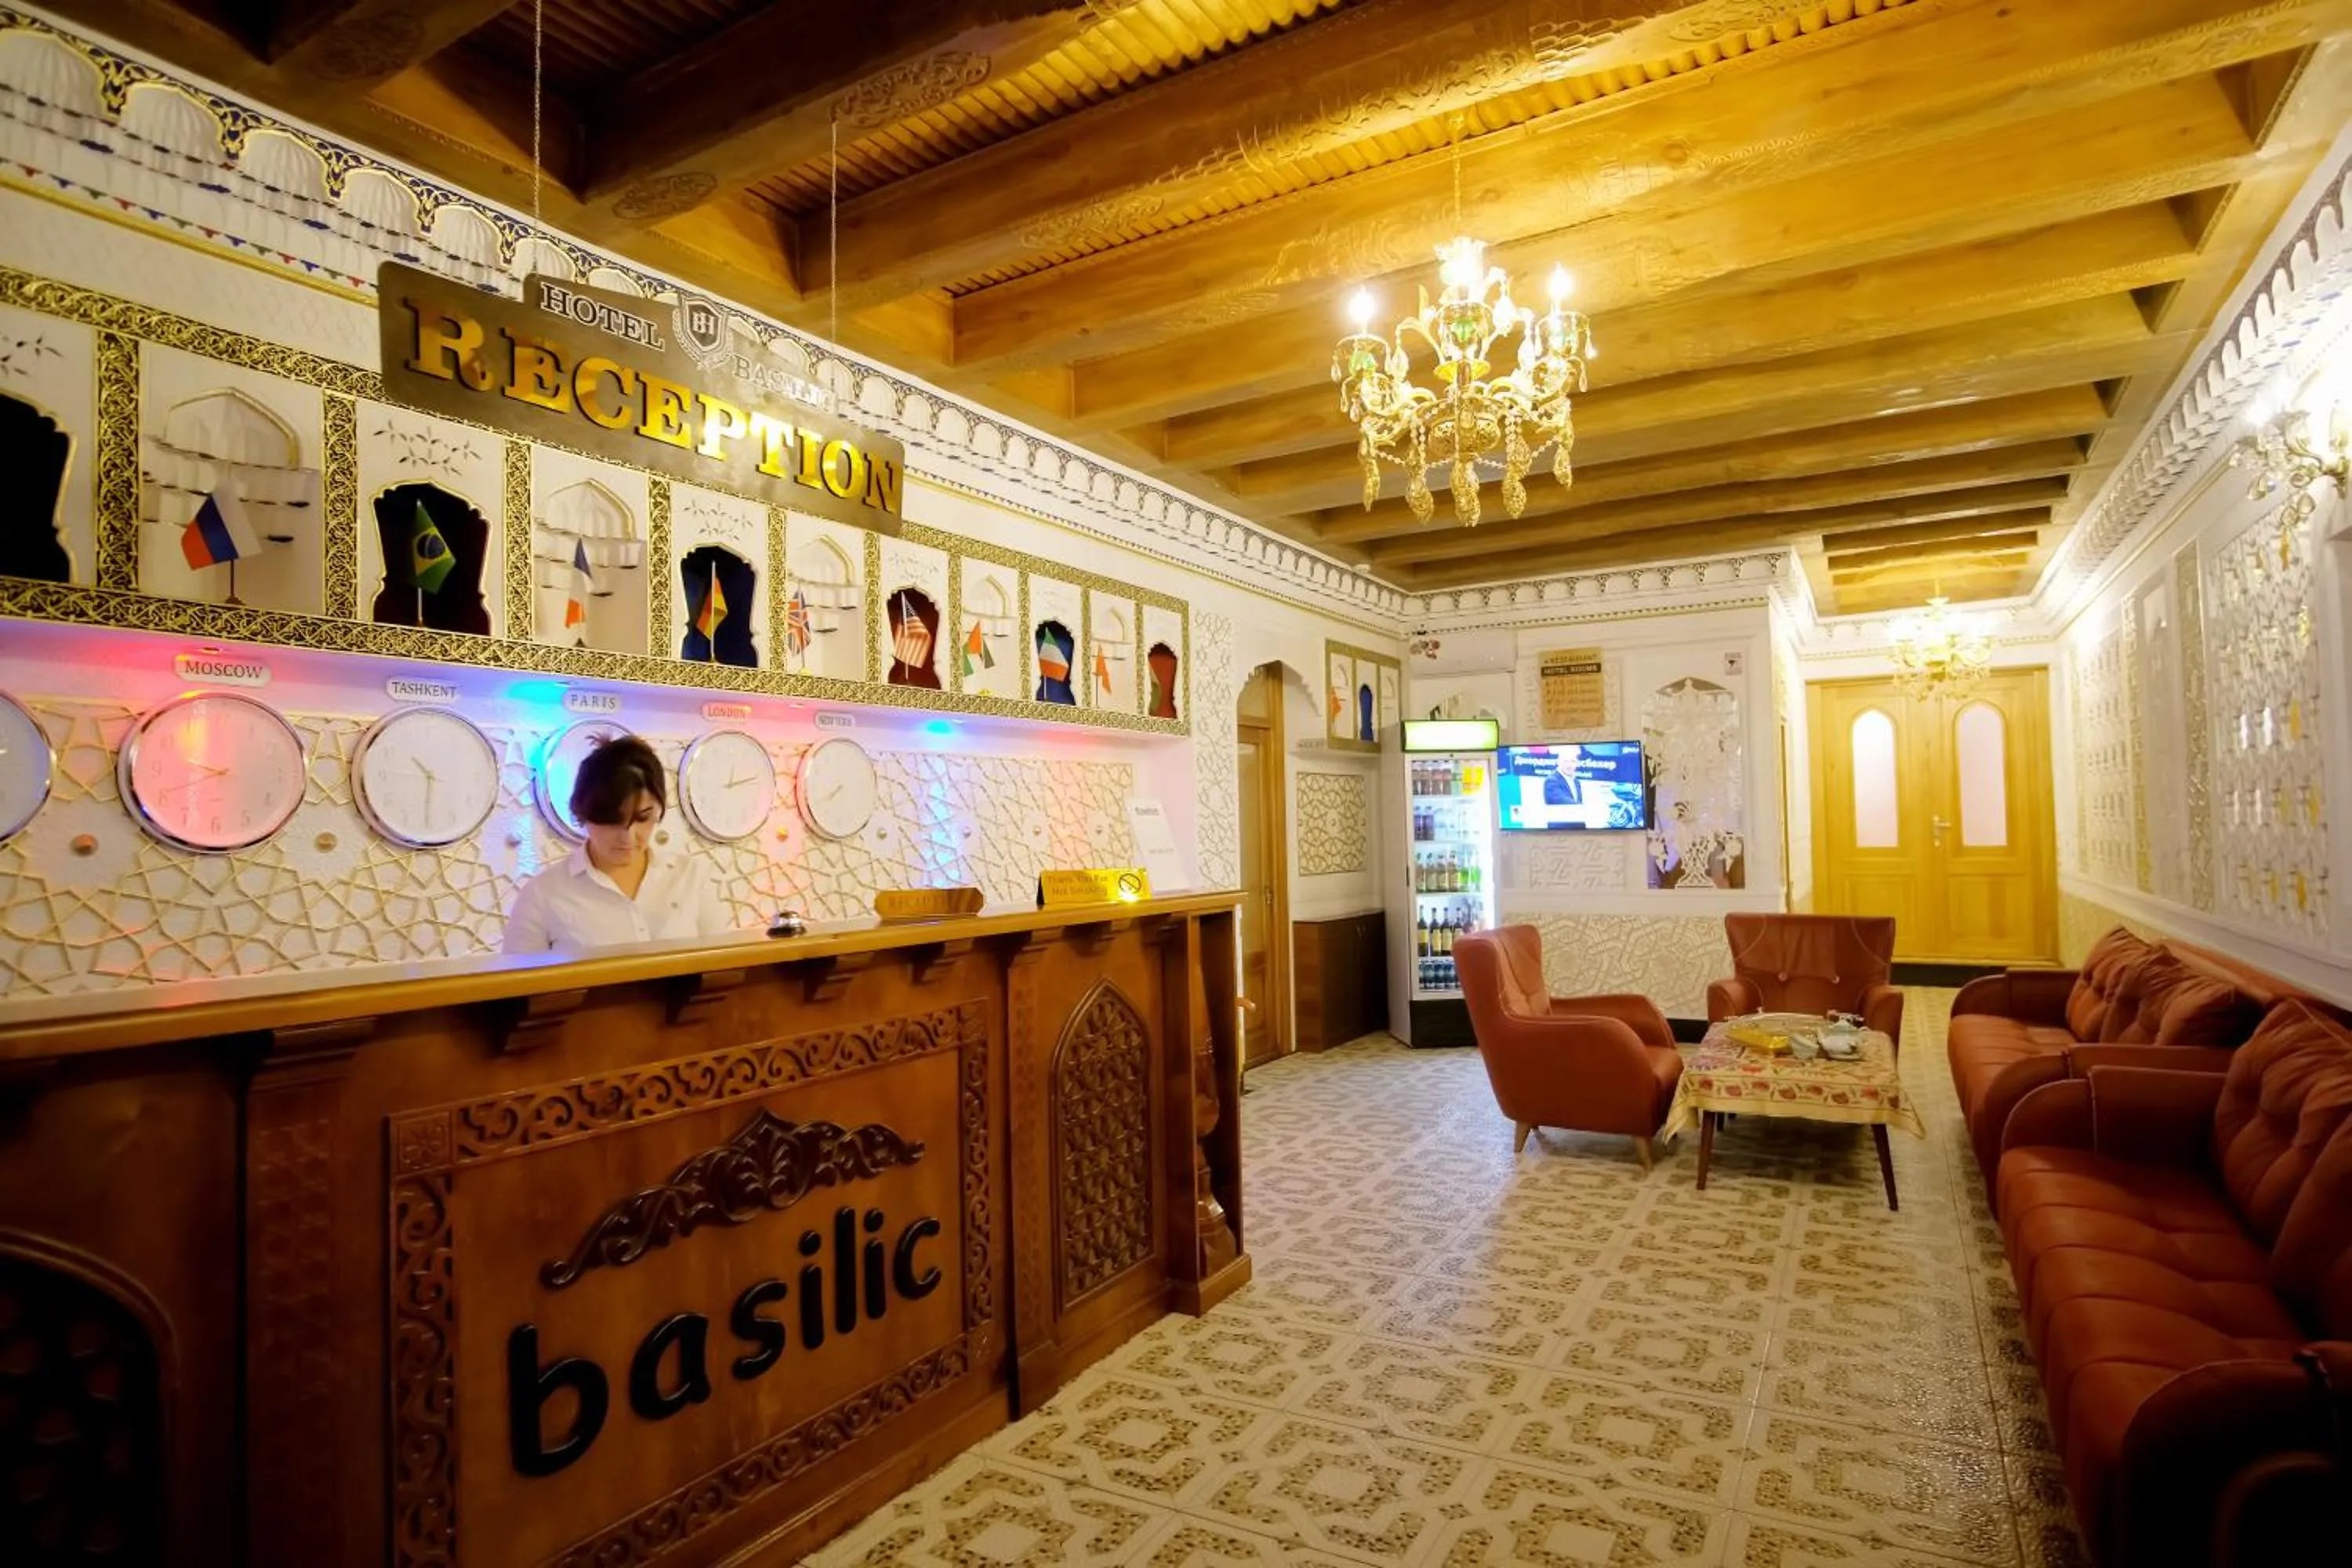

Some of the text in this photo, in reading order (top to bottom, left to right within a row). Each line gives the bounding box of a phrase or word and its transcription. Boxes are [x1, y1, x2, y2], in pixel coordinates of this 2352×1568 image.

[540, 282, 665, 351] HOTEL
[733, 355, 839, 416] BASILIC
[403, 297, 899, 514] RECEPTION
[184, 659, 263, 680] MOSCOW
[392, 681, 457, 699] TASHKENT
[571, 694, 616, 709] PARIS
[708, 705, 746, 717] LONDON
[507, 1206, 942, 1477] basilic
